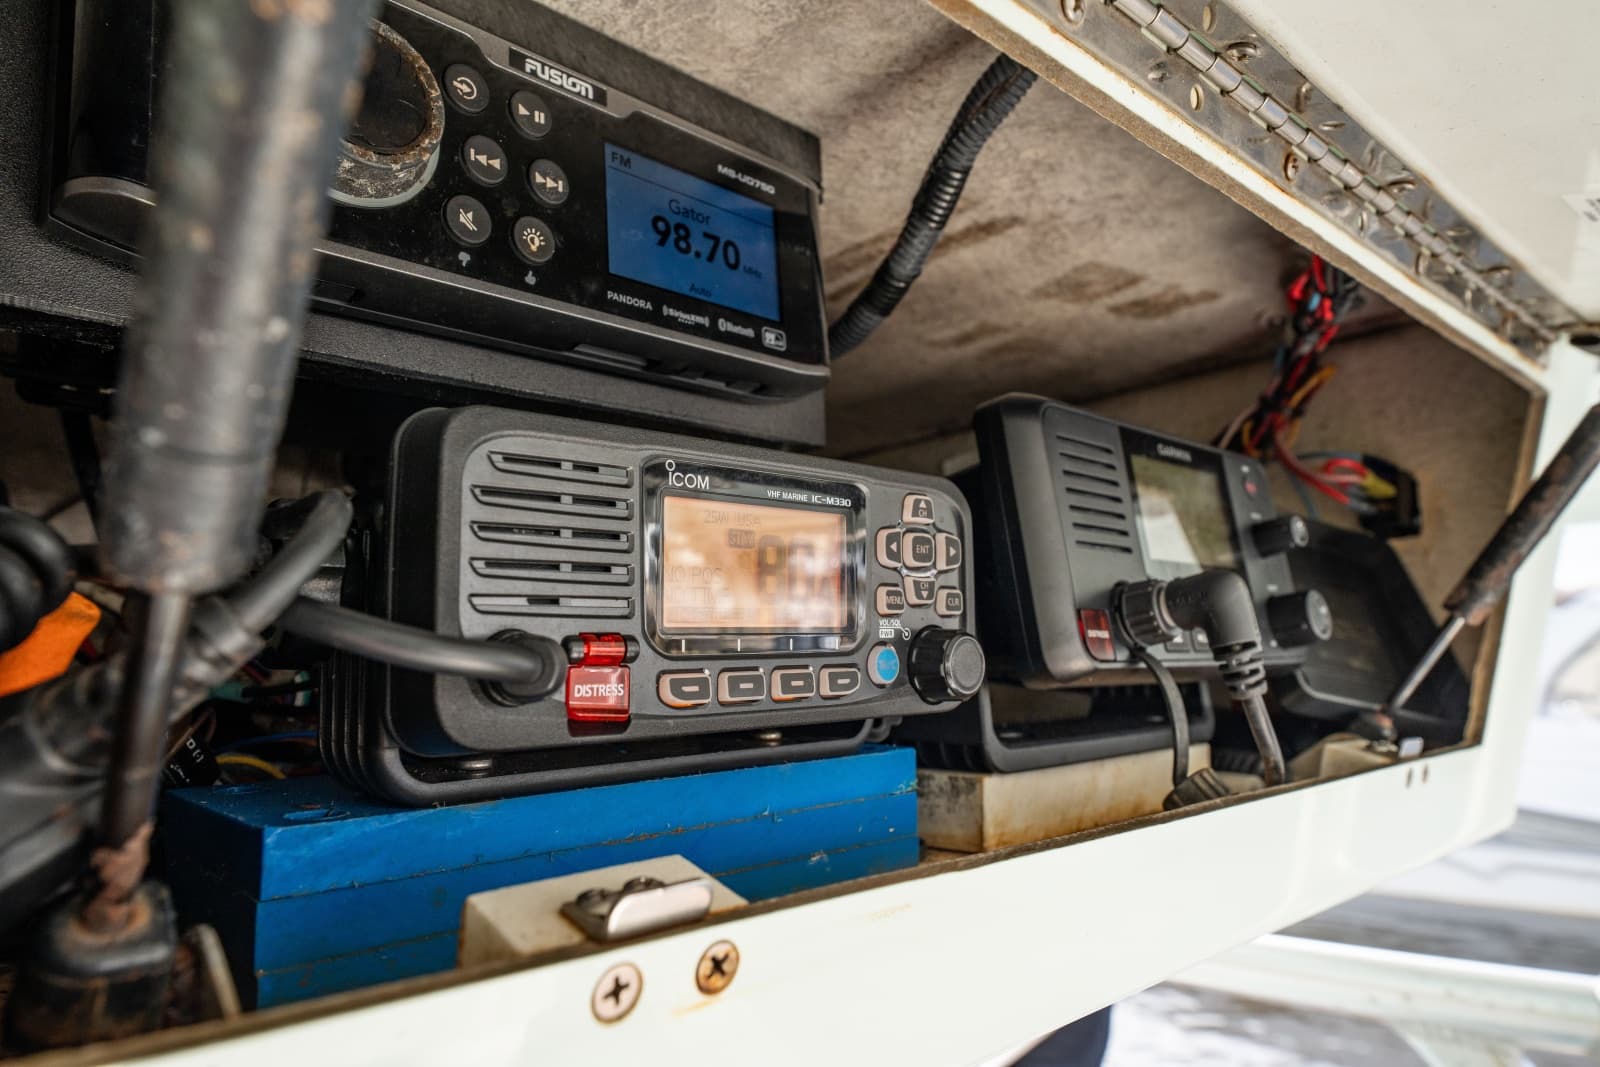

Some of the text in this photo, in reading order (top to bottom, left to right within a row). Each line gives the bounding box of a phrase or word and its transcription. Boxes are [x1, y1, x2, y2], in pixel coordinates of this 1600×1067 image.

[525, 58, 594, 99] FUSION
[611, 152, 632, 169] FM
[669, 199, 712, 225] Gator
[652, 214, 740, 270] 98.70
[607, 290, 653, 311] PANDORA
[767, 489, 851, 507] VHF MARINE IC-M330
[916, 544, 930, 554] ENT
[574, 684, 624, 698] DISTRESS
